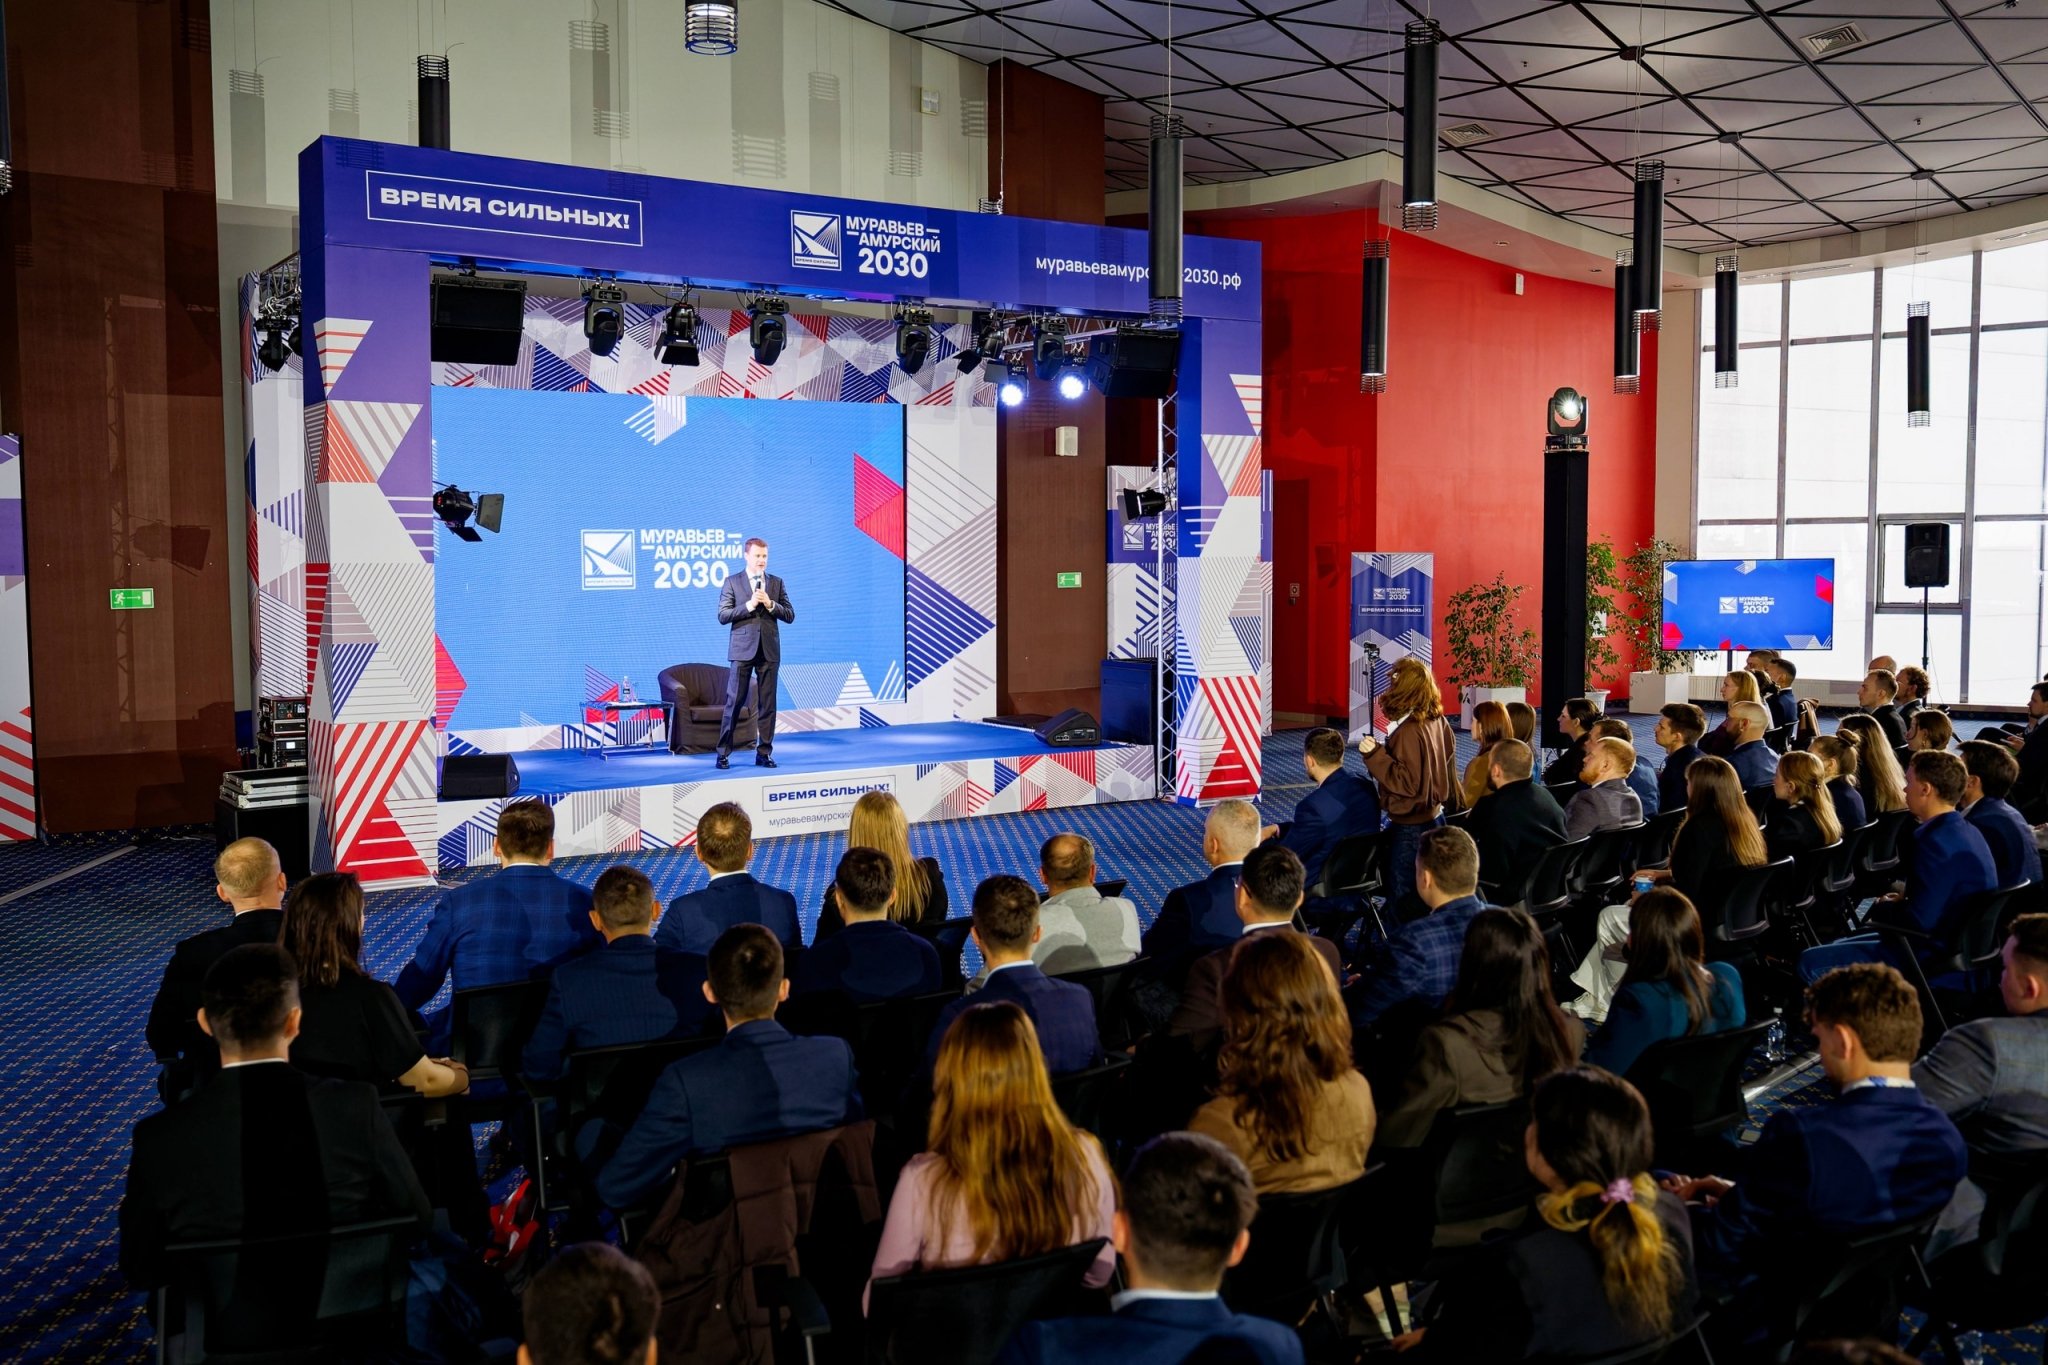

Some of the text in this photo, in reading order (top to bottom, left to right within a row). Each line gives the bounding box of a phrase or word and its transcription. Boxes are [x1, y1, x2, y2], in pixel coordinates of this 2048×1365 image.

[380, 187, 630, 230] ВРЕМЯ СИЛЬНЫХ!
[858, 248, 929, 279] 2030
[654, 561, 729, 589] 2030
[1743, 605, 1769, 614] 2030
[769, 783, 890, 802] ВРЕМЯ СИЛЬНЫХ!
